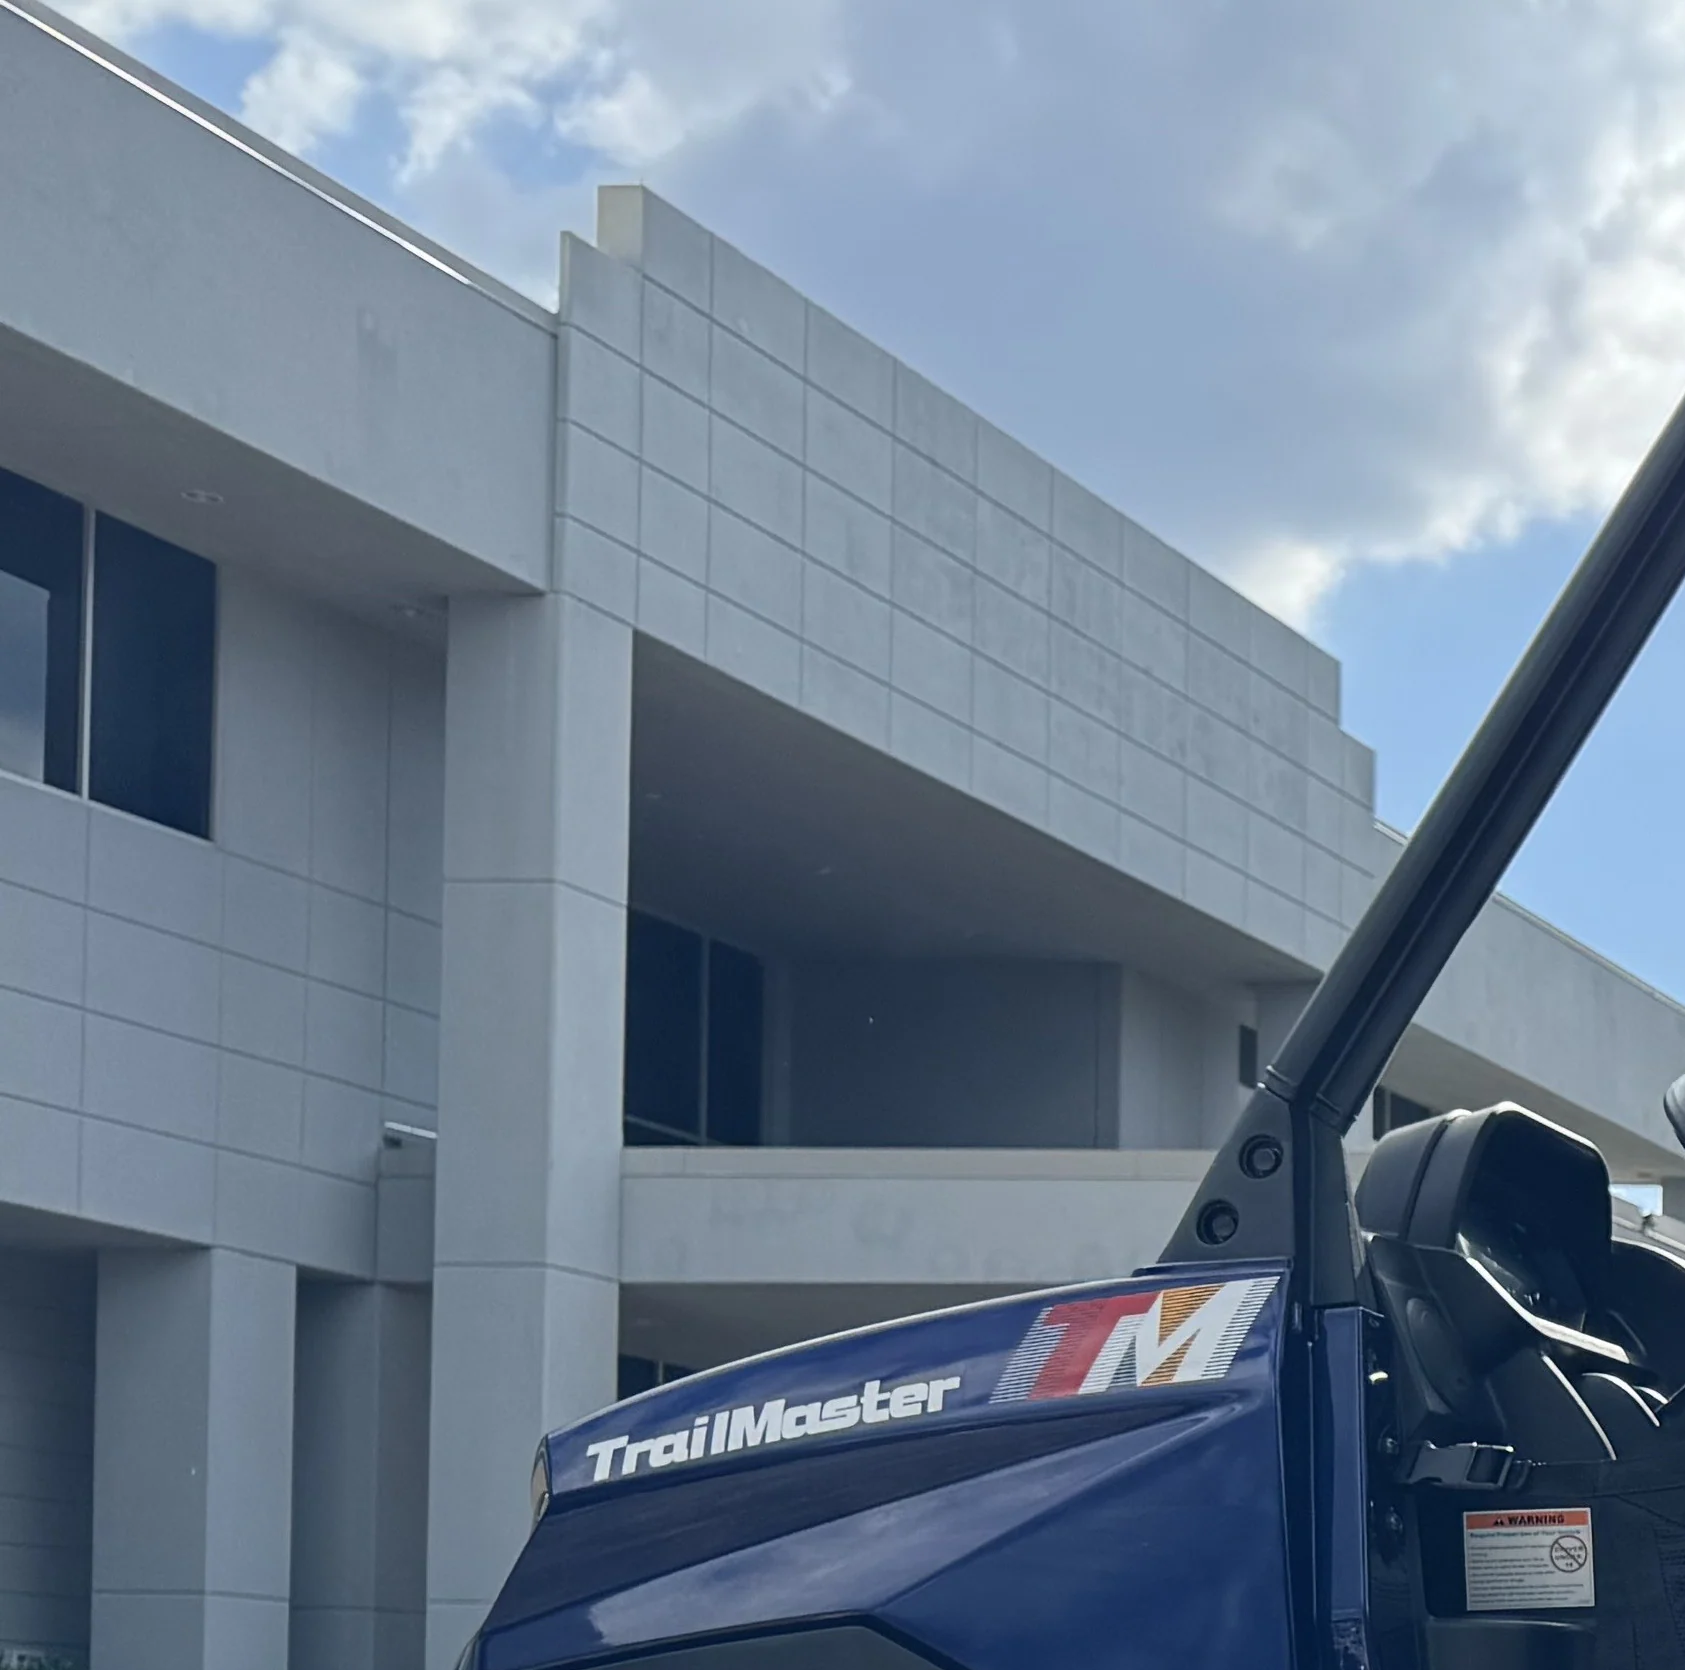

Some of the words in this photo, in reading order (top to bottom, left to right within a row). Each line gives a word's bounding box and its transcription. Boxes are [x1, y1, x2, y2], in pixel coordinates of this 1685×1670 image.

[990, 1276, 1281, 1403] TM
[586, 1376, 960, 1483] TrailMaster
[1508, 1514, 1565, 1525] WARNING
